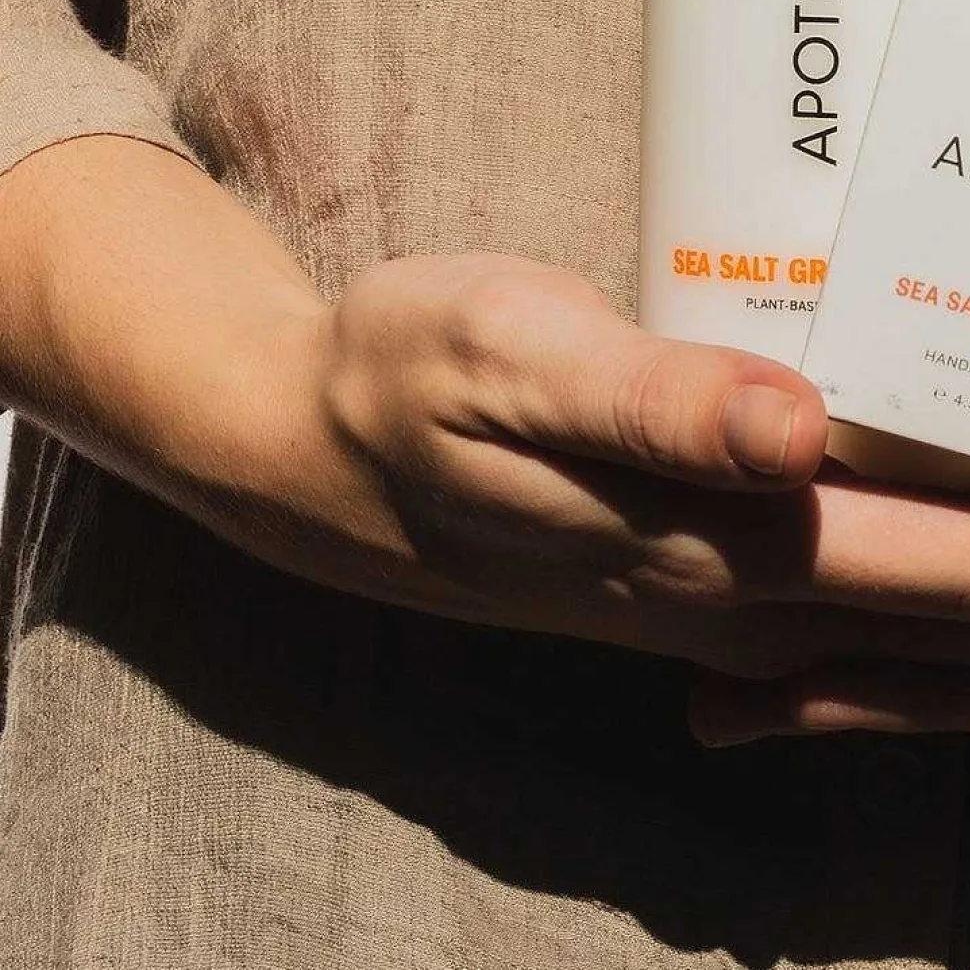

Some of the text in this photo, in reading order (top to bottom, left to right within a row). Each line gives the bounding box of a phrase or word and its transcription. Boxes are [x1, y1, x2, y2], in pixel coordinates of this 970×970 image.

[674, 248, 710, 277] SEA
[720, 253, 778, 282] SALT
[746, 298, 818, 312] PLANT-BAS
[895, 277, 937, 306] SEA
